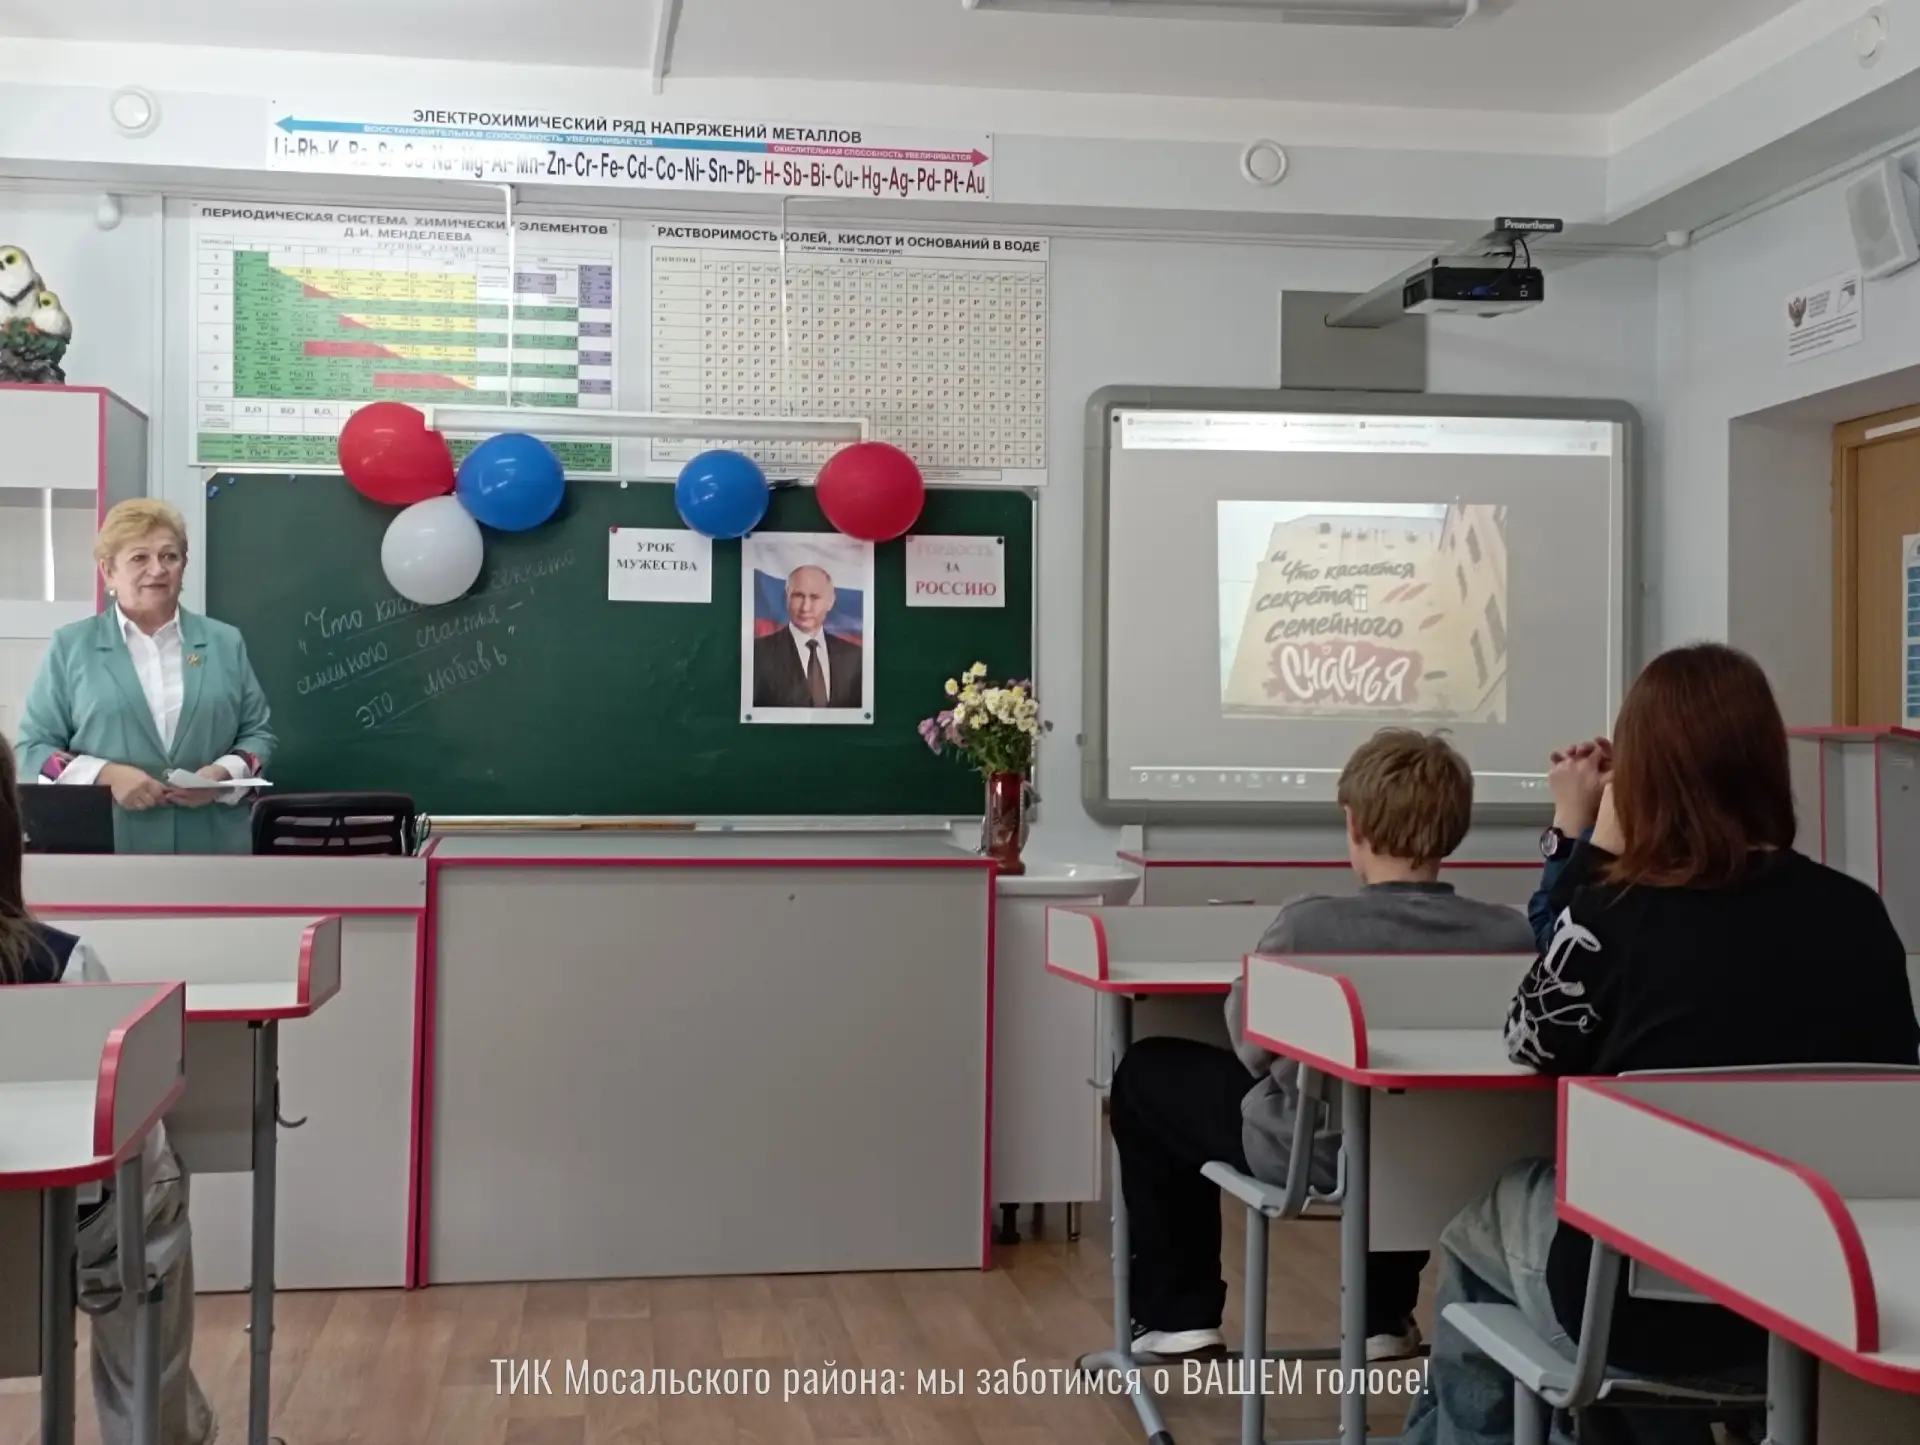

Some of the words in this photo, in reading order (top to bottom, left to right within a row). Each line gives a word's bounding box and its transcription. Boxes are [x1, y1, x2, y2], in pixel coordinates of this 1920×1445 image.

[413, 108, 607, 132] ЭЛЕКТРОХИМИЧЕСКИЙ
[612, 118, 646, 135] РЯД
[651, 120, 767, 140] НАПРЯЖЕНИЙ
[771, 127, 862, 144] МЕТАЛЛОВ
[485, 131, 564, 143] СПОСОБНОСТЬ
[565, 135, 653, 147] УВЕЛИЧИВАЕТСЯ
[773, 144, 843, 156] ОКИСЛИТЕЛЬНАЯ
[845, 148, 904, 159] СПОСОБНОСТЬ
[202, 207, 333, 223] ПЕРИОДИЧЕСКАЯ
[337, 213, 408, 226] СИСТЕМА
[519, 221, 609, 235] ЭЛЕМЕНТОВ
[1504, 219, 1555, 230] Promethean
[378, 229, 472, 242] МЕНДЕЛЕЕВА
[657, 226, 778, 242] РАСТВОРИМОСТЬ
[838, 234, 892, 247] КИСЛОТ
[895, 236, 905, 248] И
[907, 236, 990, 250] ОСНОВАНИЙ
[993, 240, 1001, 251] В
[1004, 241, 1041, 253] ВОДЕ
[637, 541, 676, 553] УРОК
[616, 558, 699, 572] МУЖЕСТВА
[915, 580, 997, 596] РОССИЮ
[1264, 613, 1404, 643] семейного
